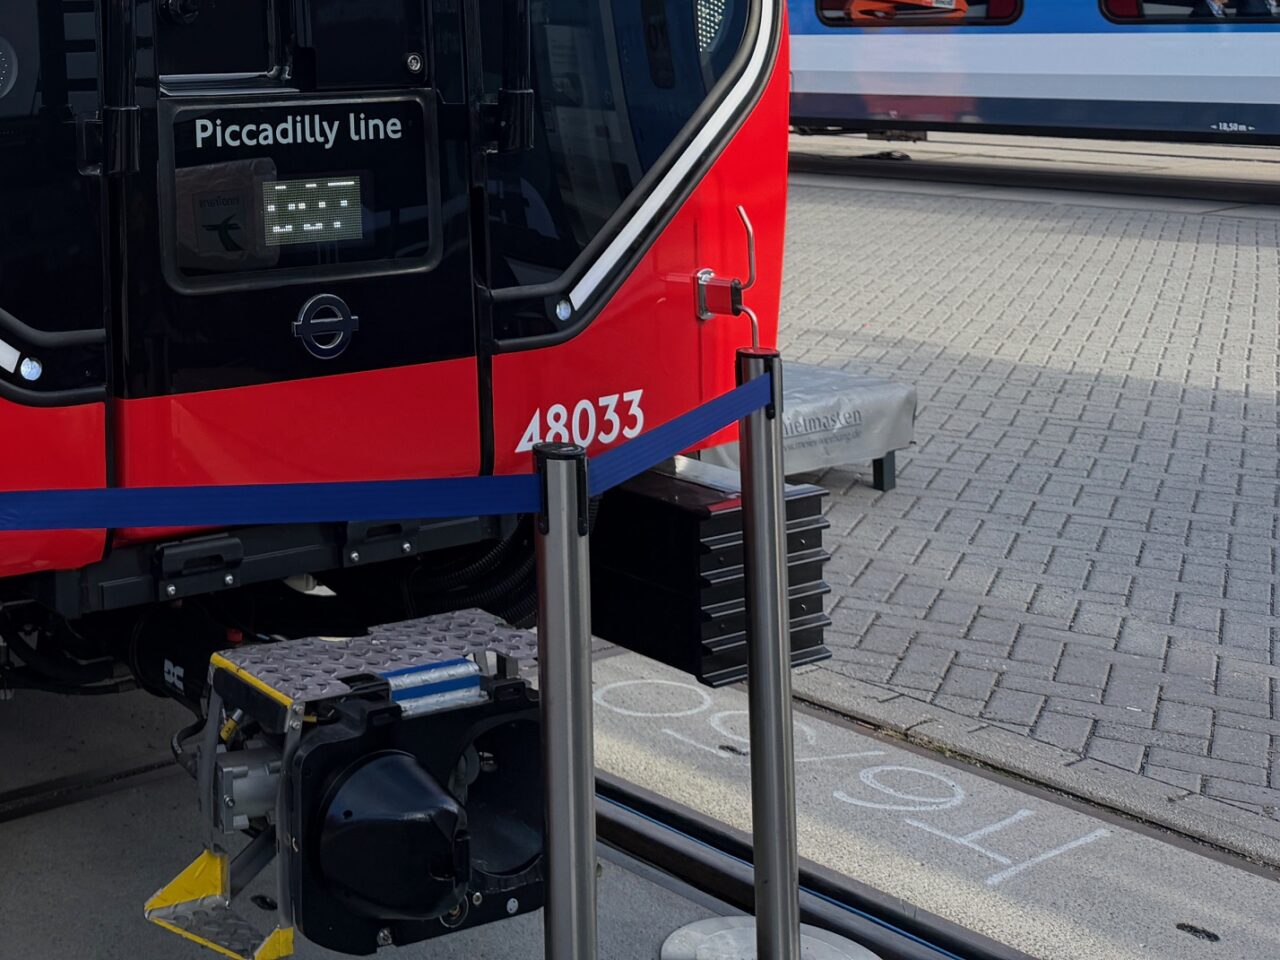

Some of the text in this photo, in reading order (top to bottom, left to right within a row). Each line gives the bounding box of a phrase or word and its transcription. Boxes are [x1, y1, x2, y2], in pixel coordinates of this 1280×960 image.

[195, 113, 403, 148] Piccadilly line
[515, 389, 644, 453] 48033
